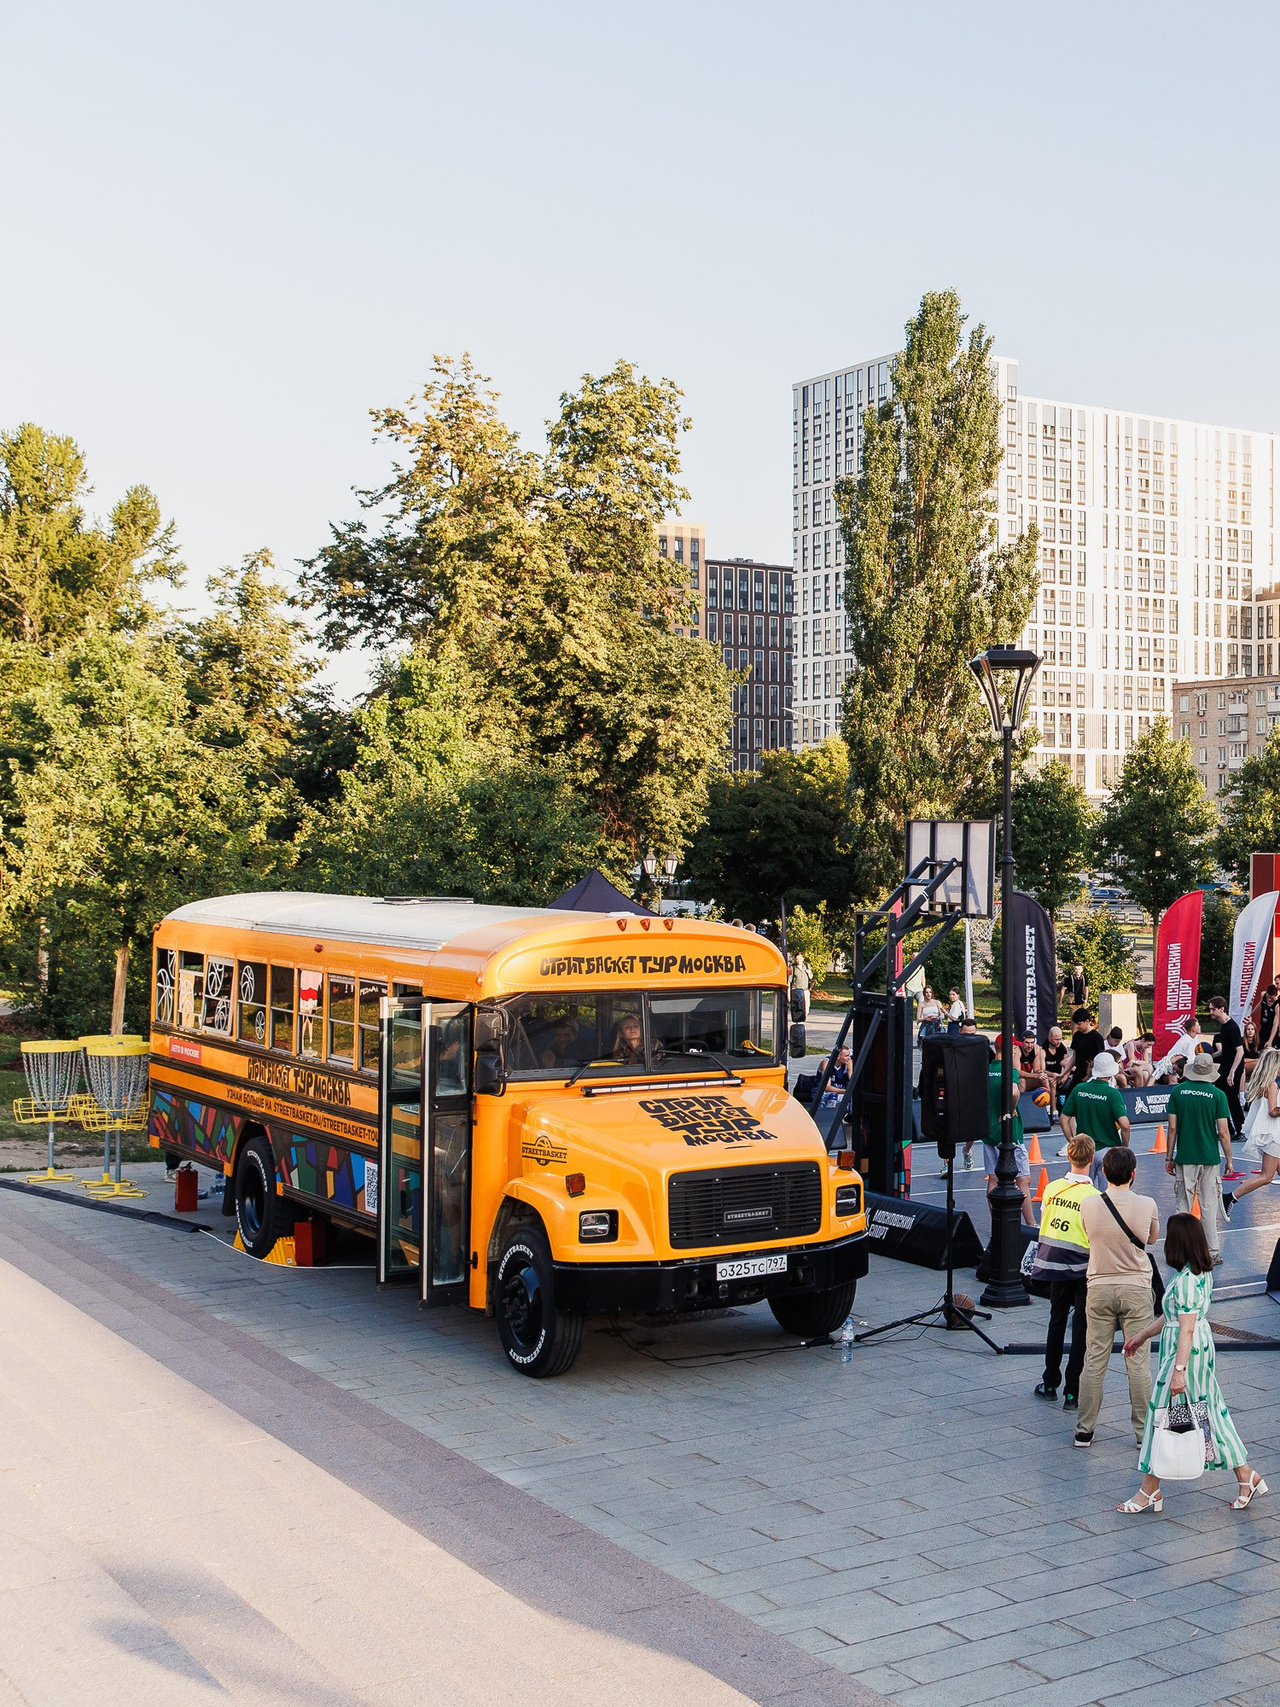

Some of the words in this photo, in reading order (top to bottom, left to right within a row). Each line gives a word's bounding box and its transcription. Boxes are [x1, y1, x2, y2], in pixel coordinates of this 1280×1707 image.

[638, 955, 679, 974] ТУР
[678, 954, 747, 975] МОСКВА
[1166, 942, 1182, 1011] МОСКОВСКИЙ
[1178, 977, 1193, 1011] СПОРТ
[294, 1067, 314, 1095] ТУР
[314, 1073, 351, 1106] МОСКВА
[1077, 1091, 1107, 1101] ПЕРСОНАЛ
[1180, 1089, 1214, 1099] ПЕРСОНАЛ
[638, 1095, 733, 1114] СТРИТ
[650, 1106, 753, 1128] БАСКЕТ
[668, 1117, 761, 1136] ТУР
[682, 1129, 779, 1147] МОСКВА
[522, 1146, 568, 1159] STREETBASKET
[727, 1210, 769, 1221] STREETBASKET
[873, 1209, 917, 1230] МОСКОВСКИЙ
[1050, 1217, 1070, 1232] 466
[868, 1223, 889, 1240] СПОРТ
